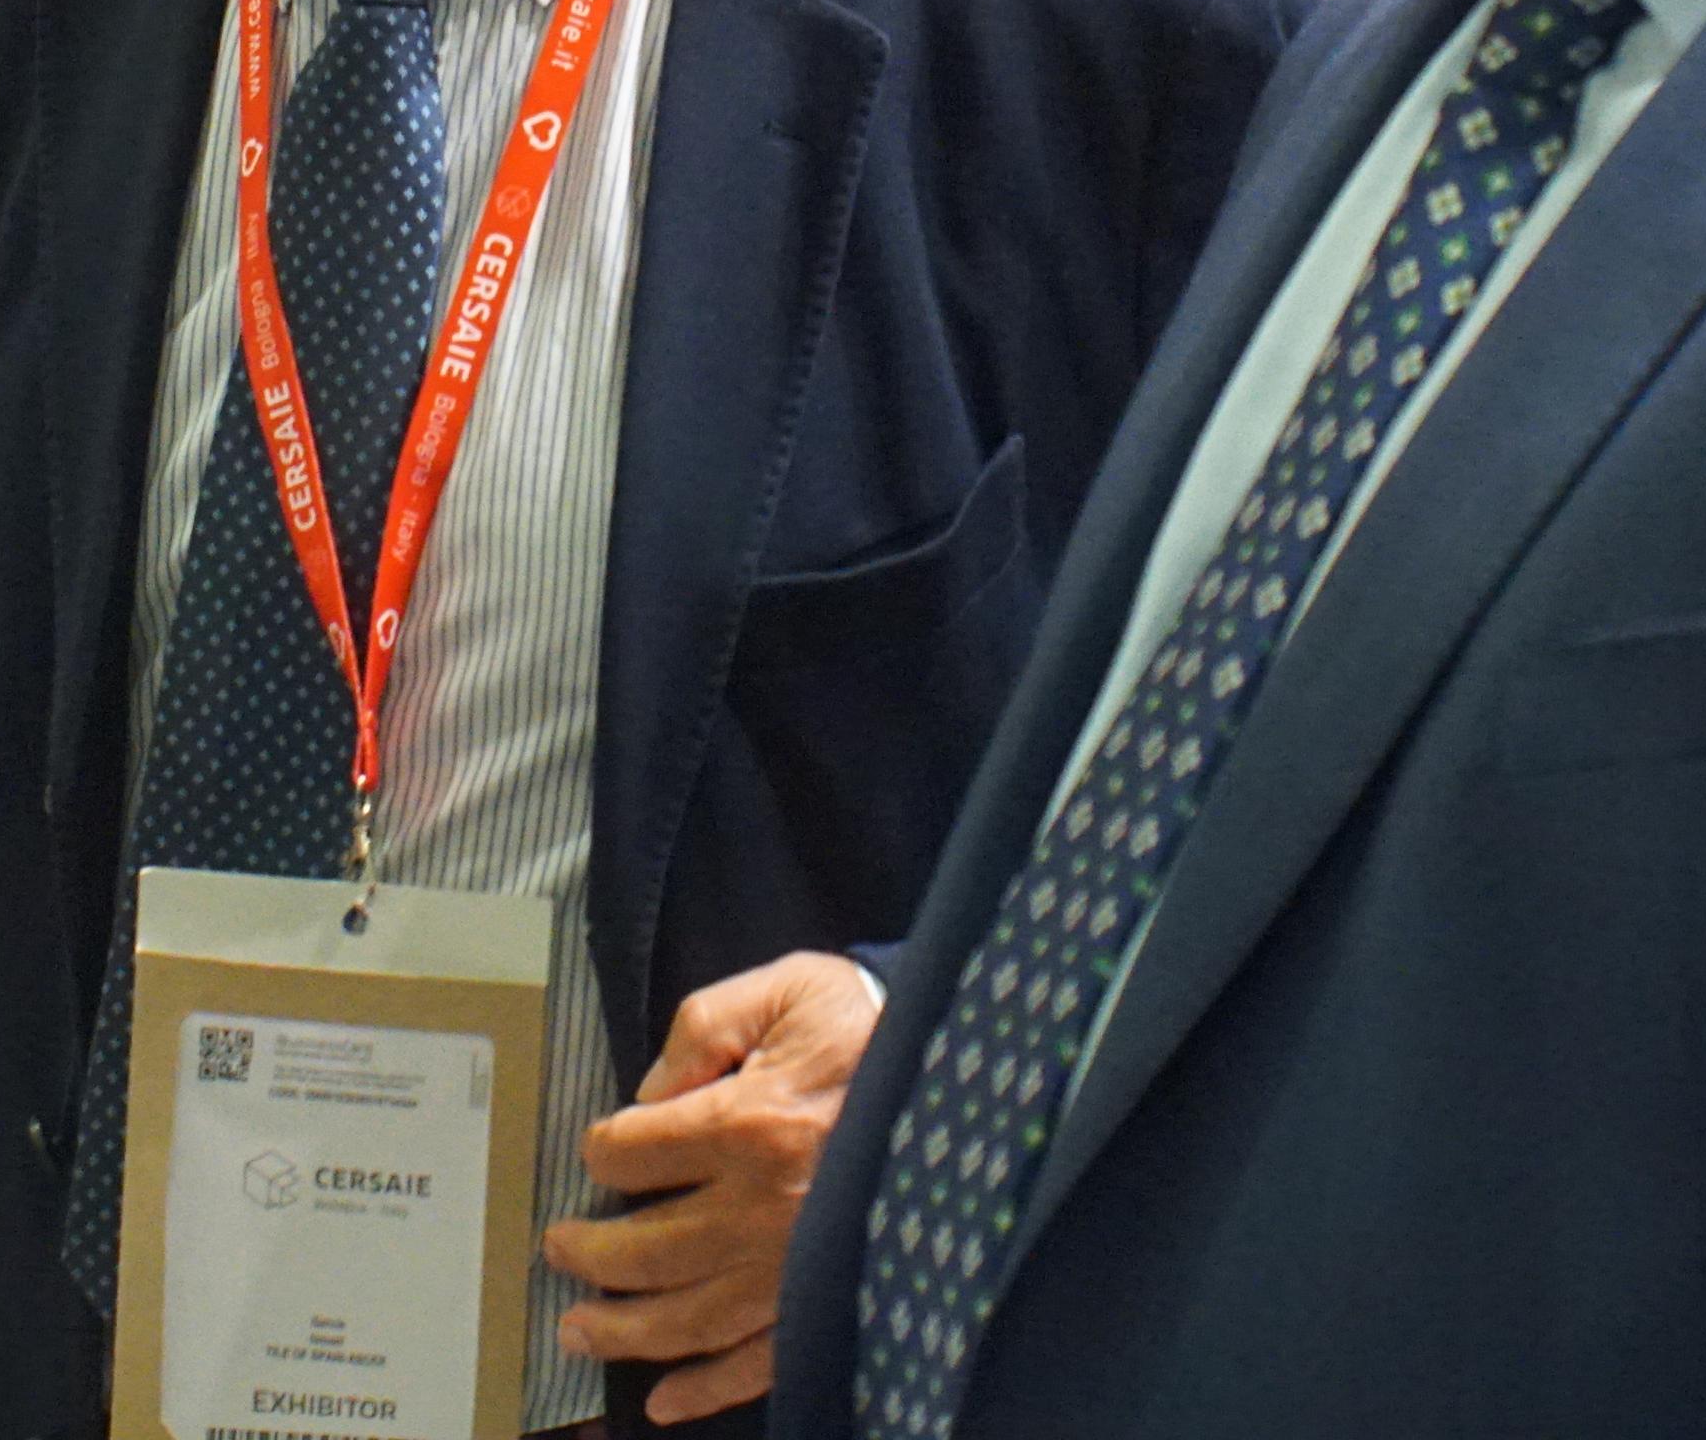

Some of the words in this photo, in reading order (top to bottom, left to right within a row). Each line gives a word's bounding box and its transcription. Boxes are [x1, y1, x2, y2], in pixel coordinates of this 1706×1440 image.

[250, 279, 280, 370] Bologna
[440, 233, 514, 383] CERSAIE
[264, 380, 317, 532] CERSAIE
[411, 392, 457, 487] Bologna
[394, 508, 420, 562] Italy
[315, 1165, 432, 1198] CERSAIE
[253, 1386, 397, 1420] EXHIBITOR
